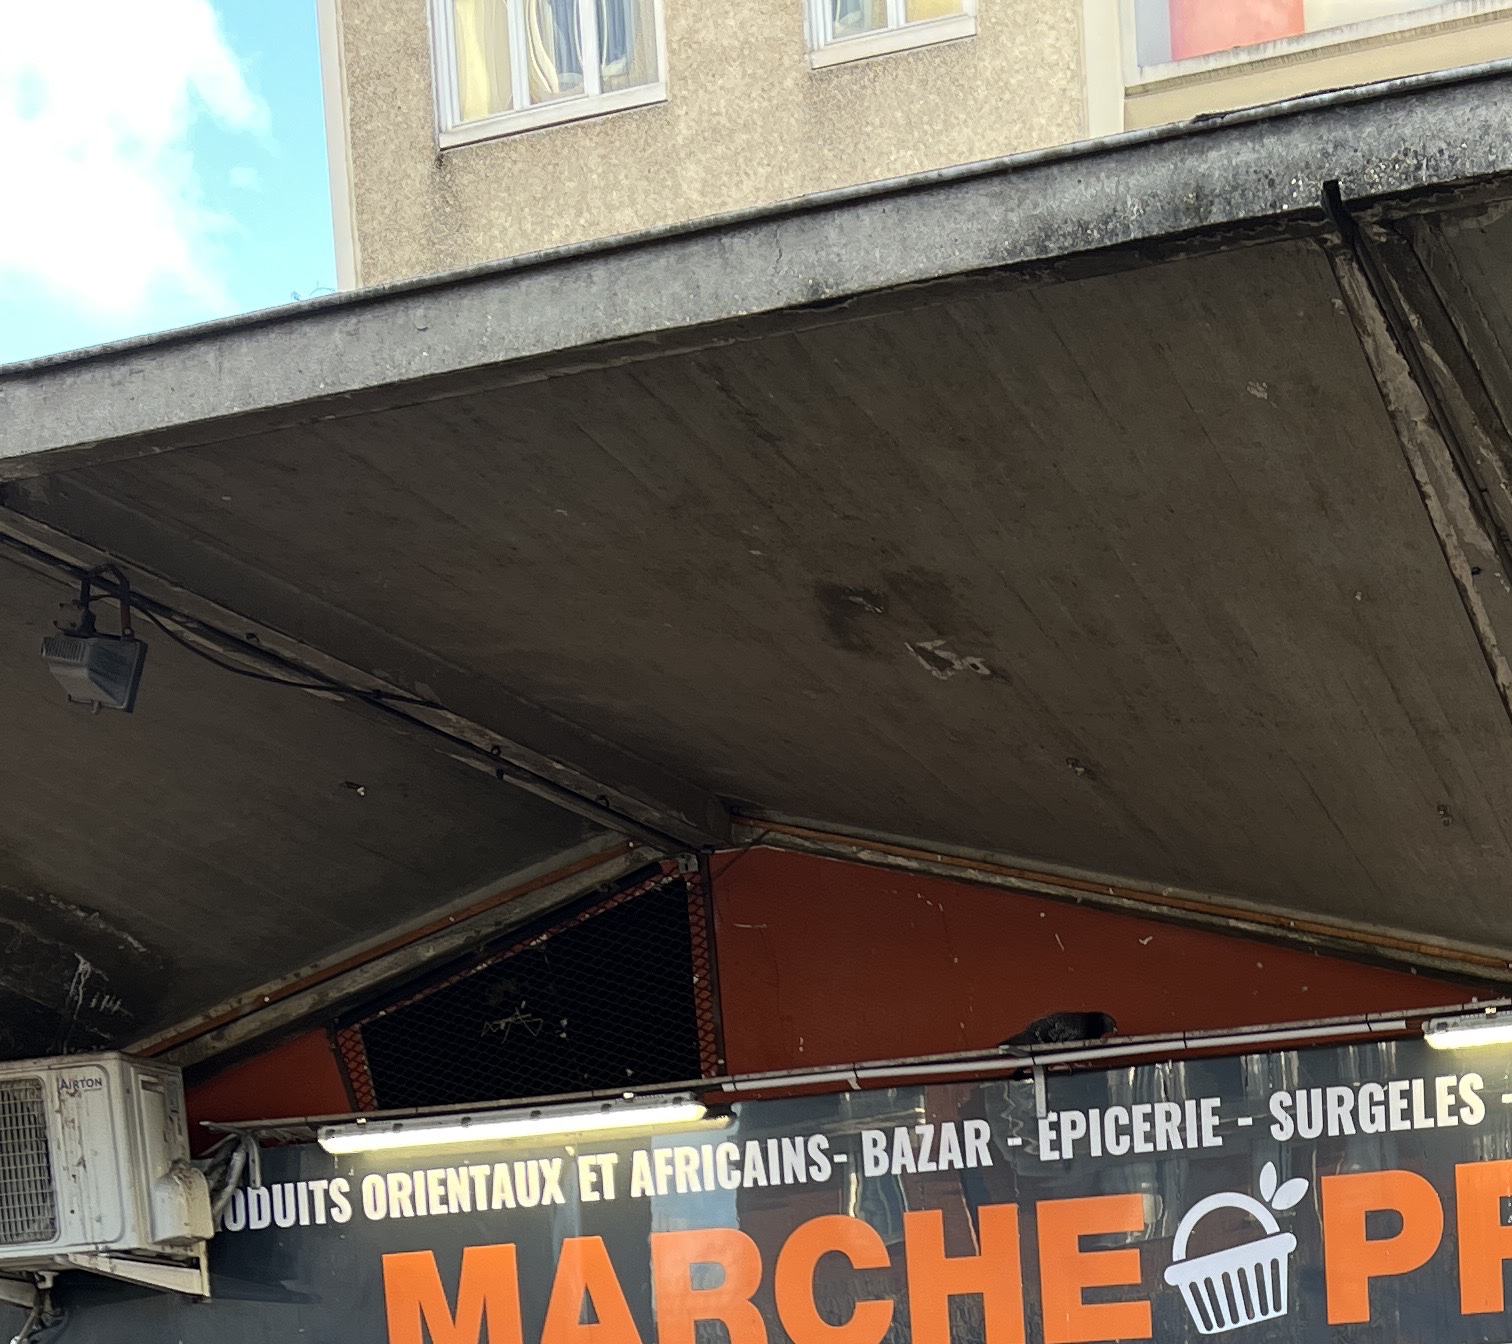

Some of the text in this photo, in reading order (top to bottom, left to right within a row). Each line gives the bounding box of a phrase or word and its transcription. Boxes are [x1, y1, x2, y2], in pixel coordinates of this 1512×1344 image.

[59, 1077, 103, 1090] AIRTON
[224, 1177, 353, 1232] ODUITS
[361, 1157, 567, 1221] ORIENTAUX
[578, 1153, 619, 1202] ET
[861, 1119, 993, 1178] BAZAR
[1270, 1073, 1485, 1143] SURGELES
